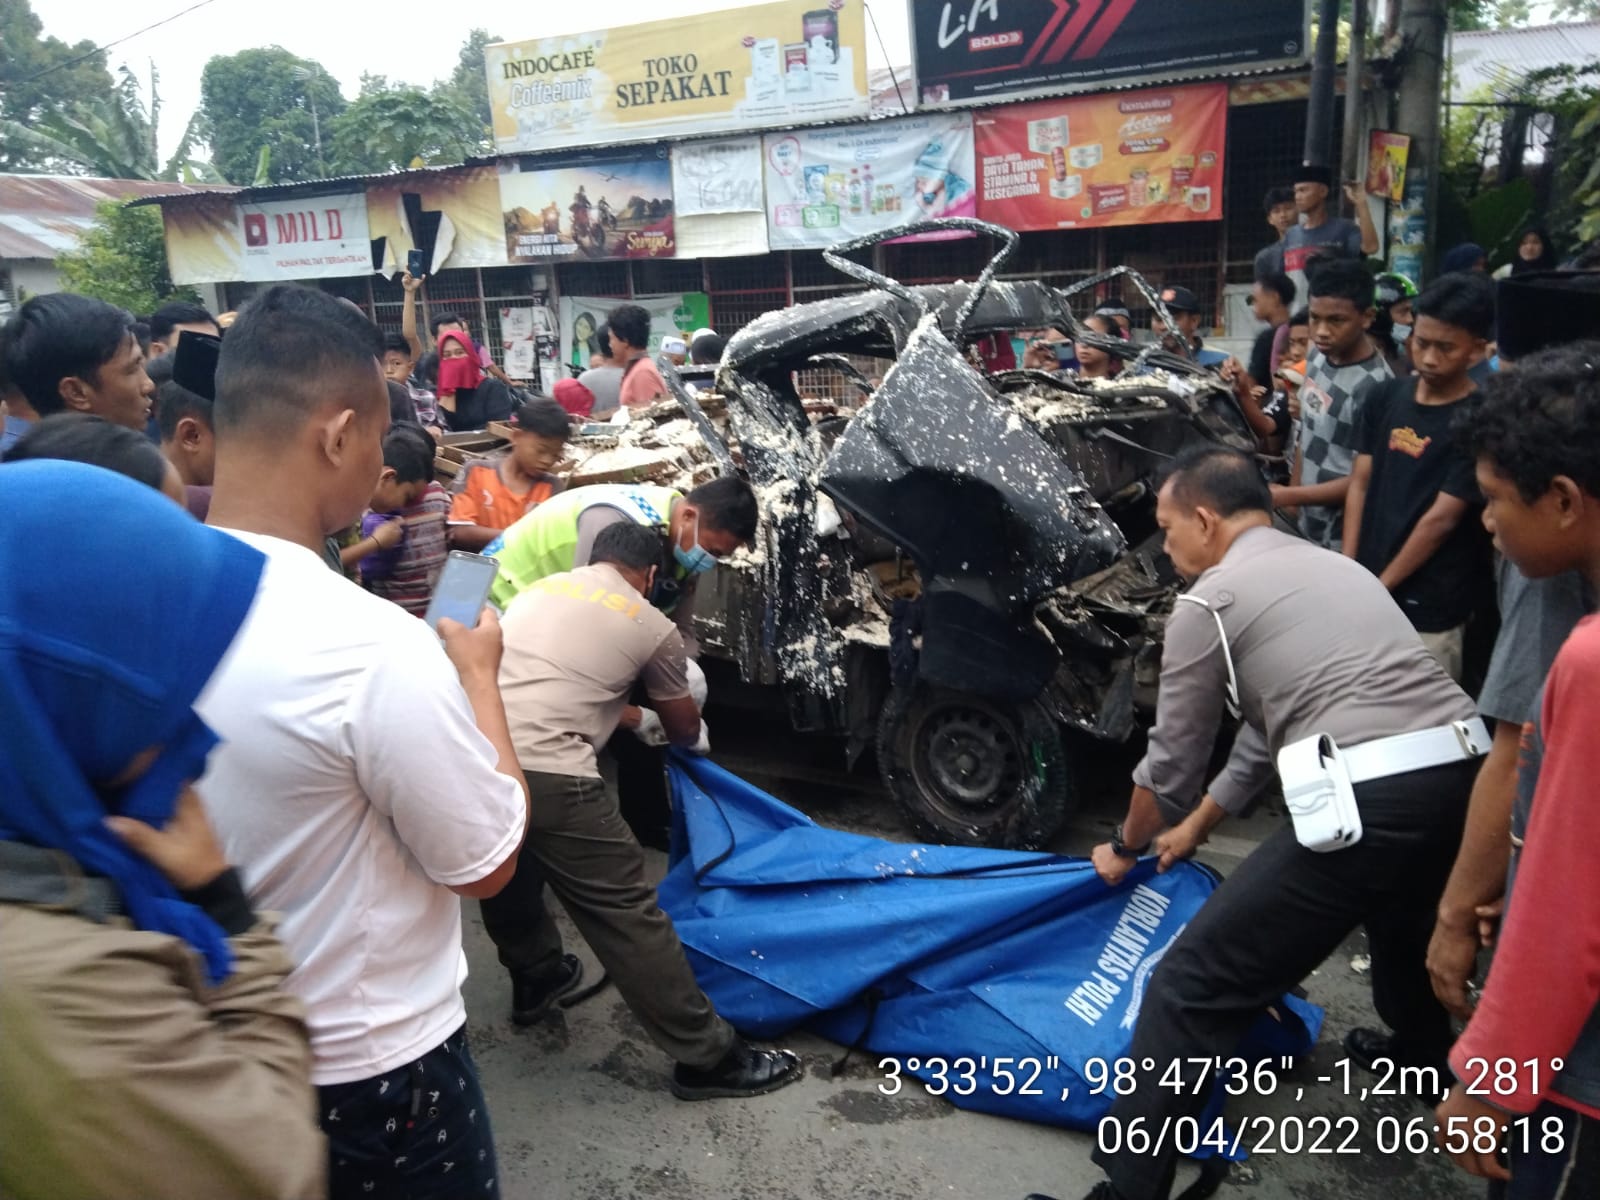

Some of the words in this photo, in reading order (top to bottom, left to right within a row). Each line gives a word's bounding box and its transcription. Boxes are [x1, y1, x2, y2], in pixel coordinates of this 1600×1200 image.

[971, 34, 1009, 49] BOLD
[503, 46, 595, 79] INDOCAFÉ
[643, 54, 698, 78] TOKO
[510, 76, 593, 109] Coffeemix
[616, 71, 732, 109] SEPAKAT
[274, 208, 343, 244] MILD
[626, 232, 674, 256] Surya
[1096, 883, 1171, 982] KORLANTAS
[1063, 970, 1122, 1028] POLRI
